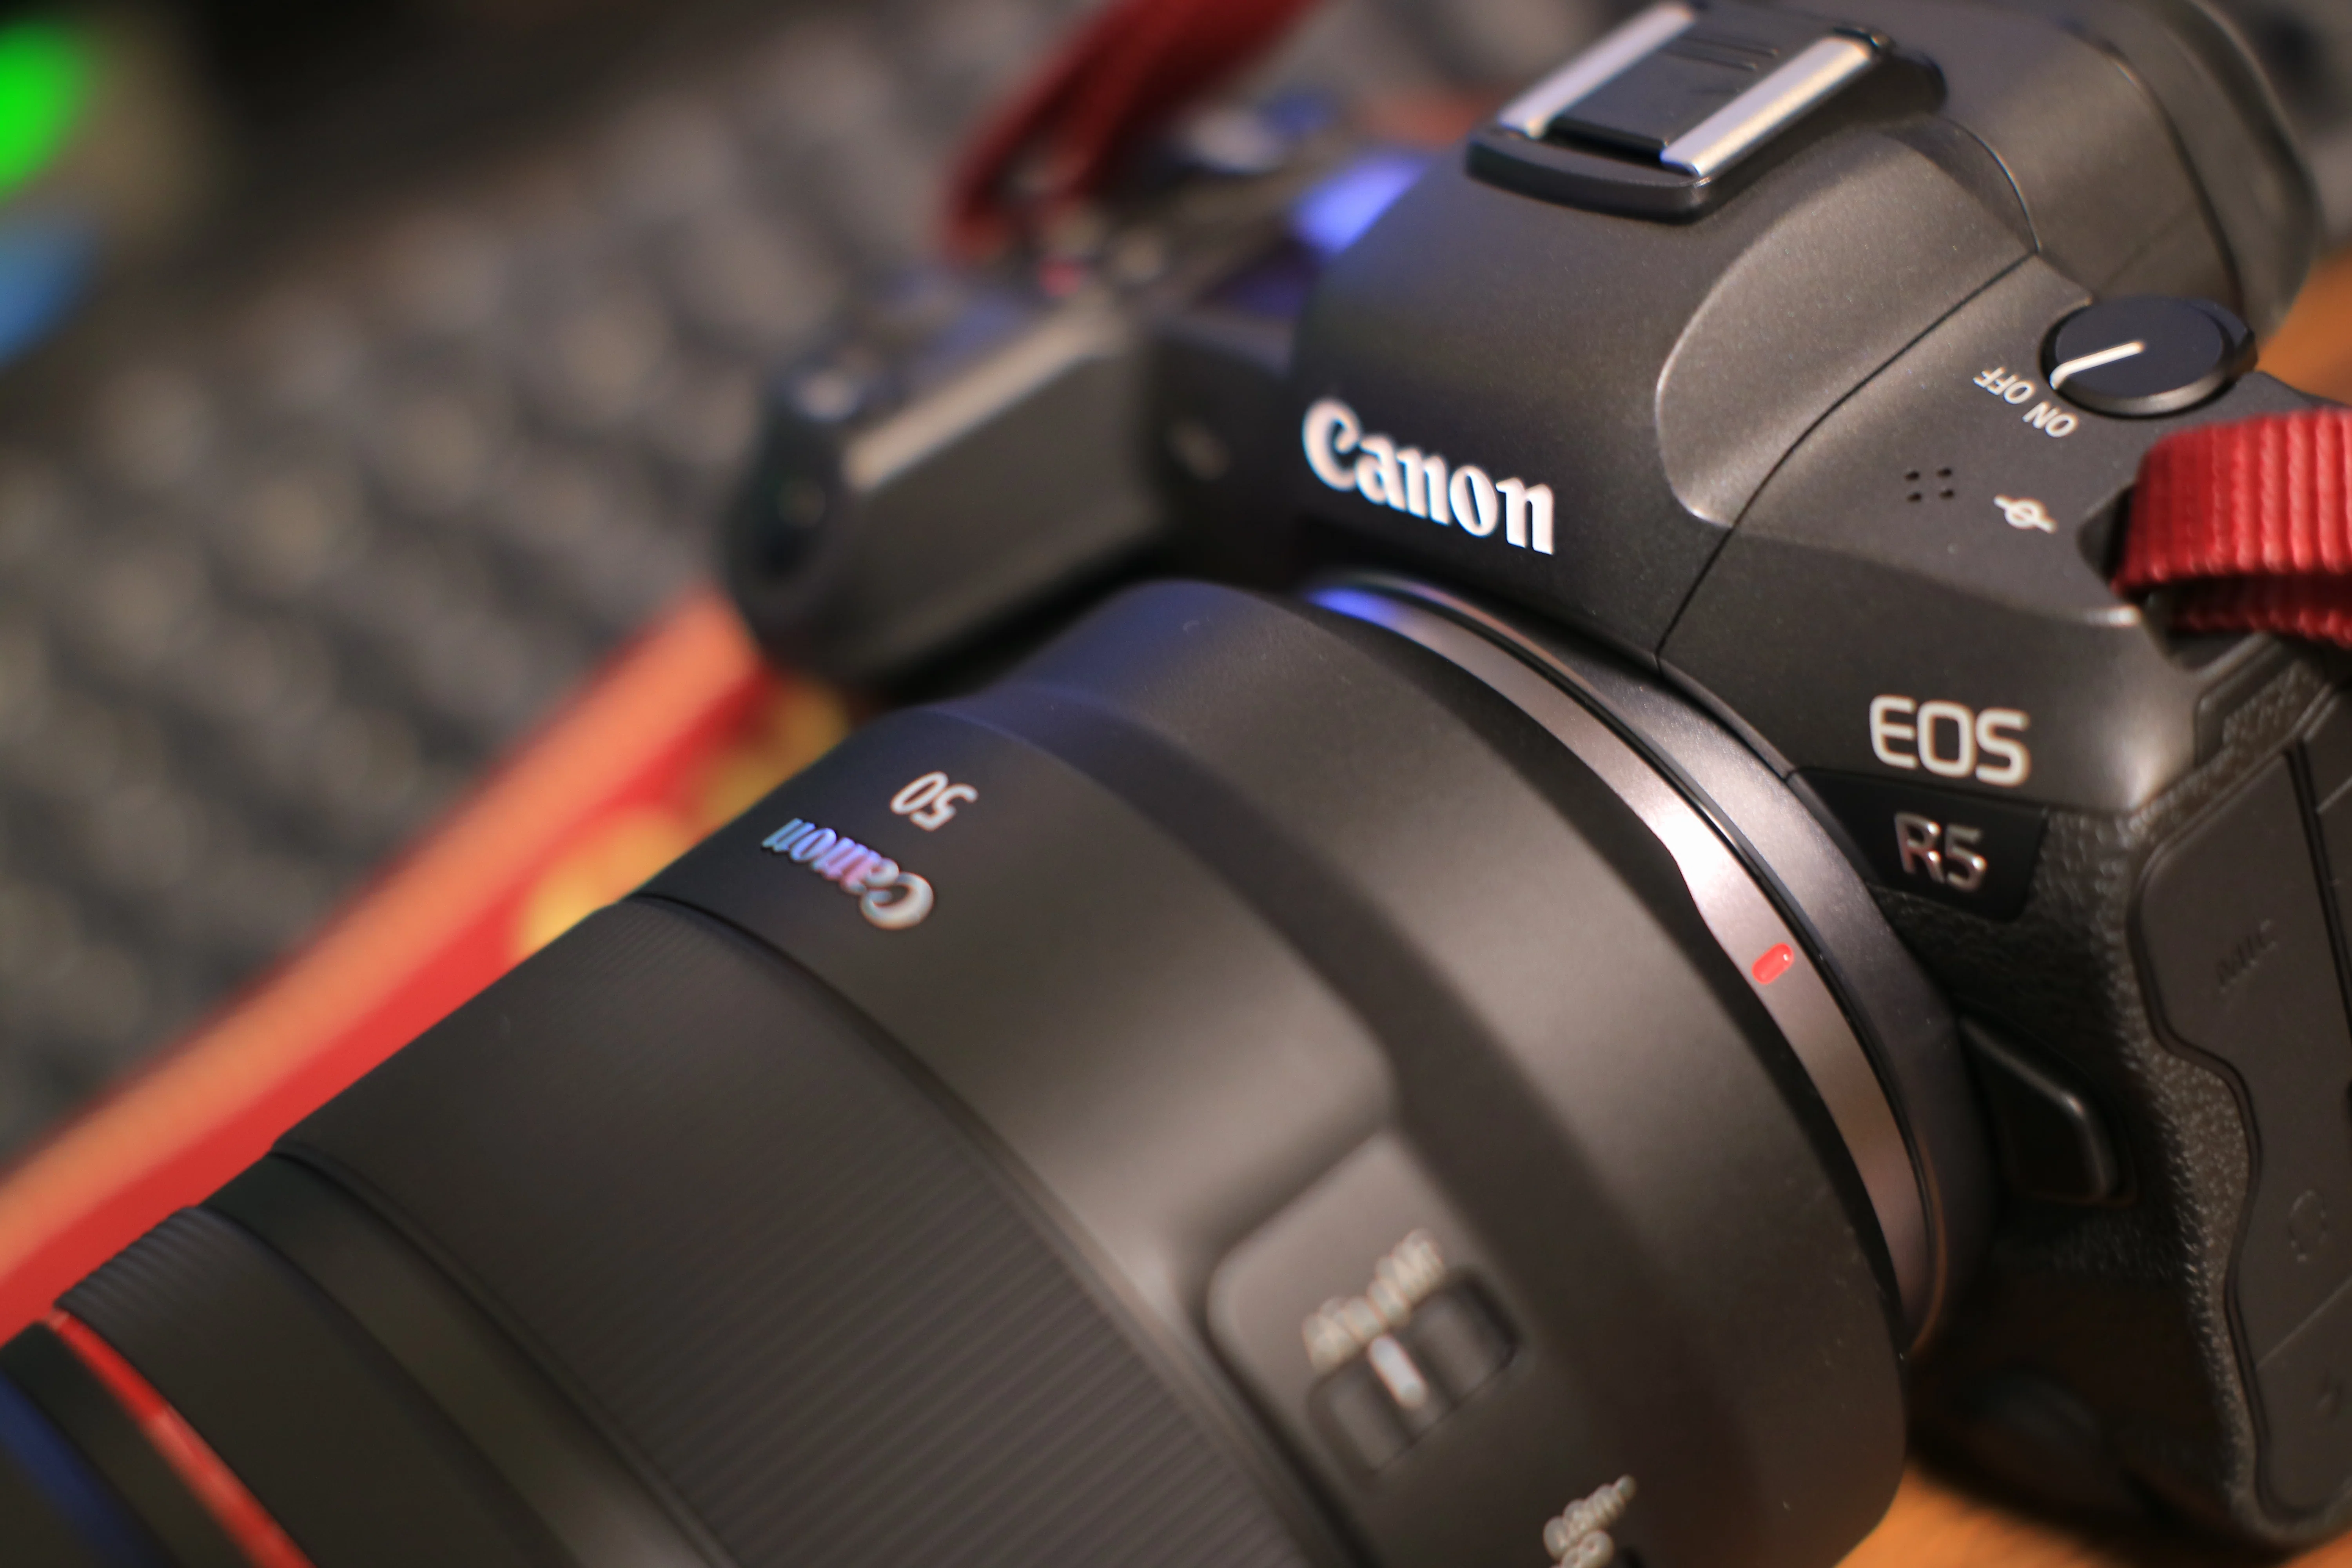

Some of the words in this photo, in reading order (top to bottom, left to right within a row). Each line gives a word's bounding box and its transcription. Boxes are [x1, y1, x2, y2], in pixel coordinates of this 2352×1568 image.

[1973, 367, 2036, 405] OFF
[2022, 400, 2078, 438] ON
[1301, 396, 1554, 555] Canon
[1869, 694, 2031, 787] EOS
[890, 771, 978, 831] 50
[760, 817, 934, 929] Canon
[1894, 812, 1987, 892] R5
